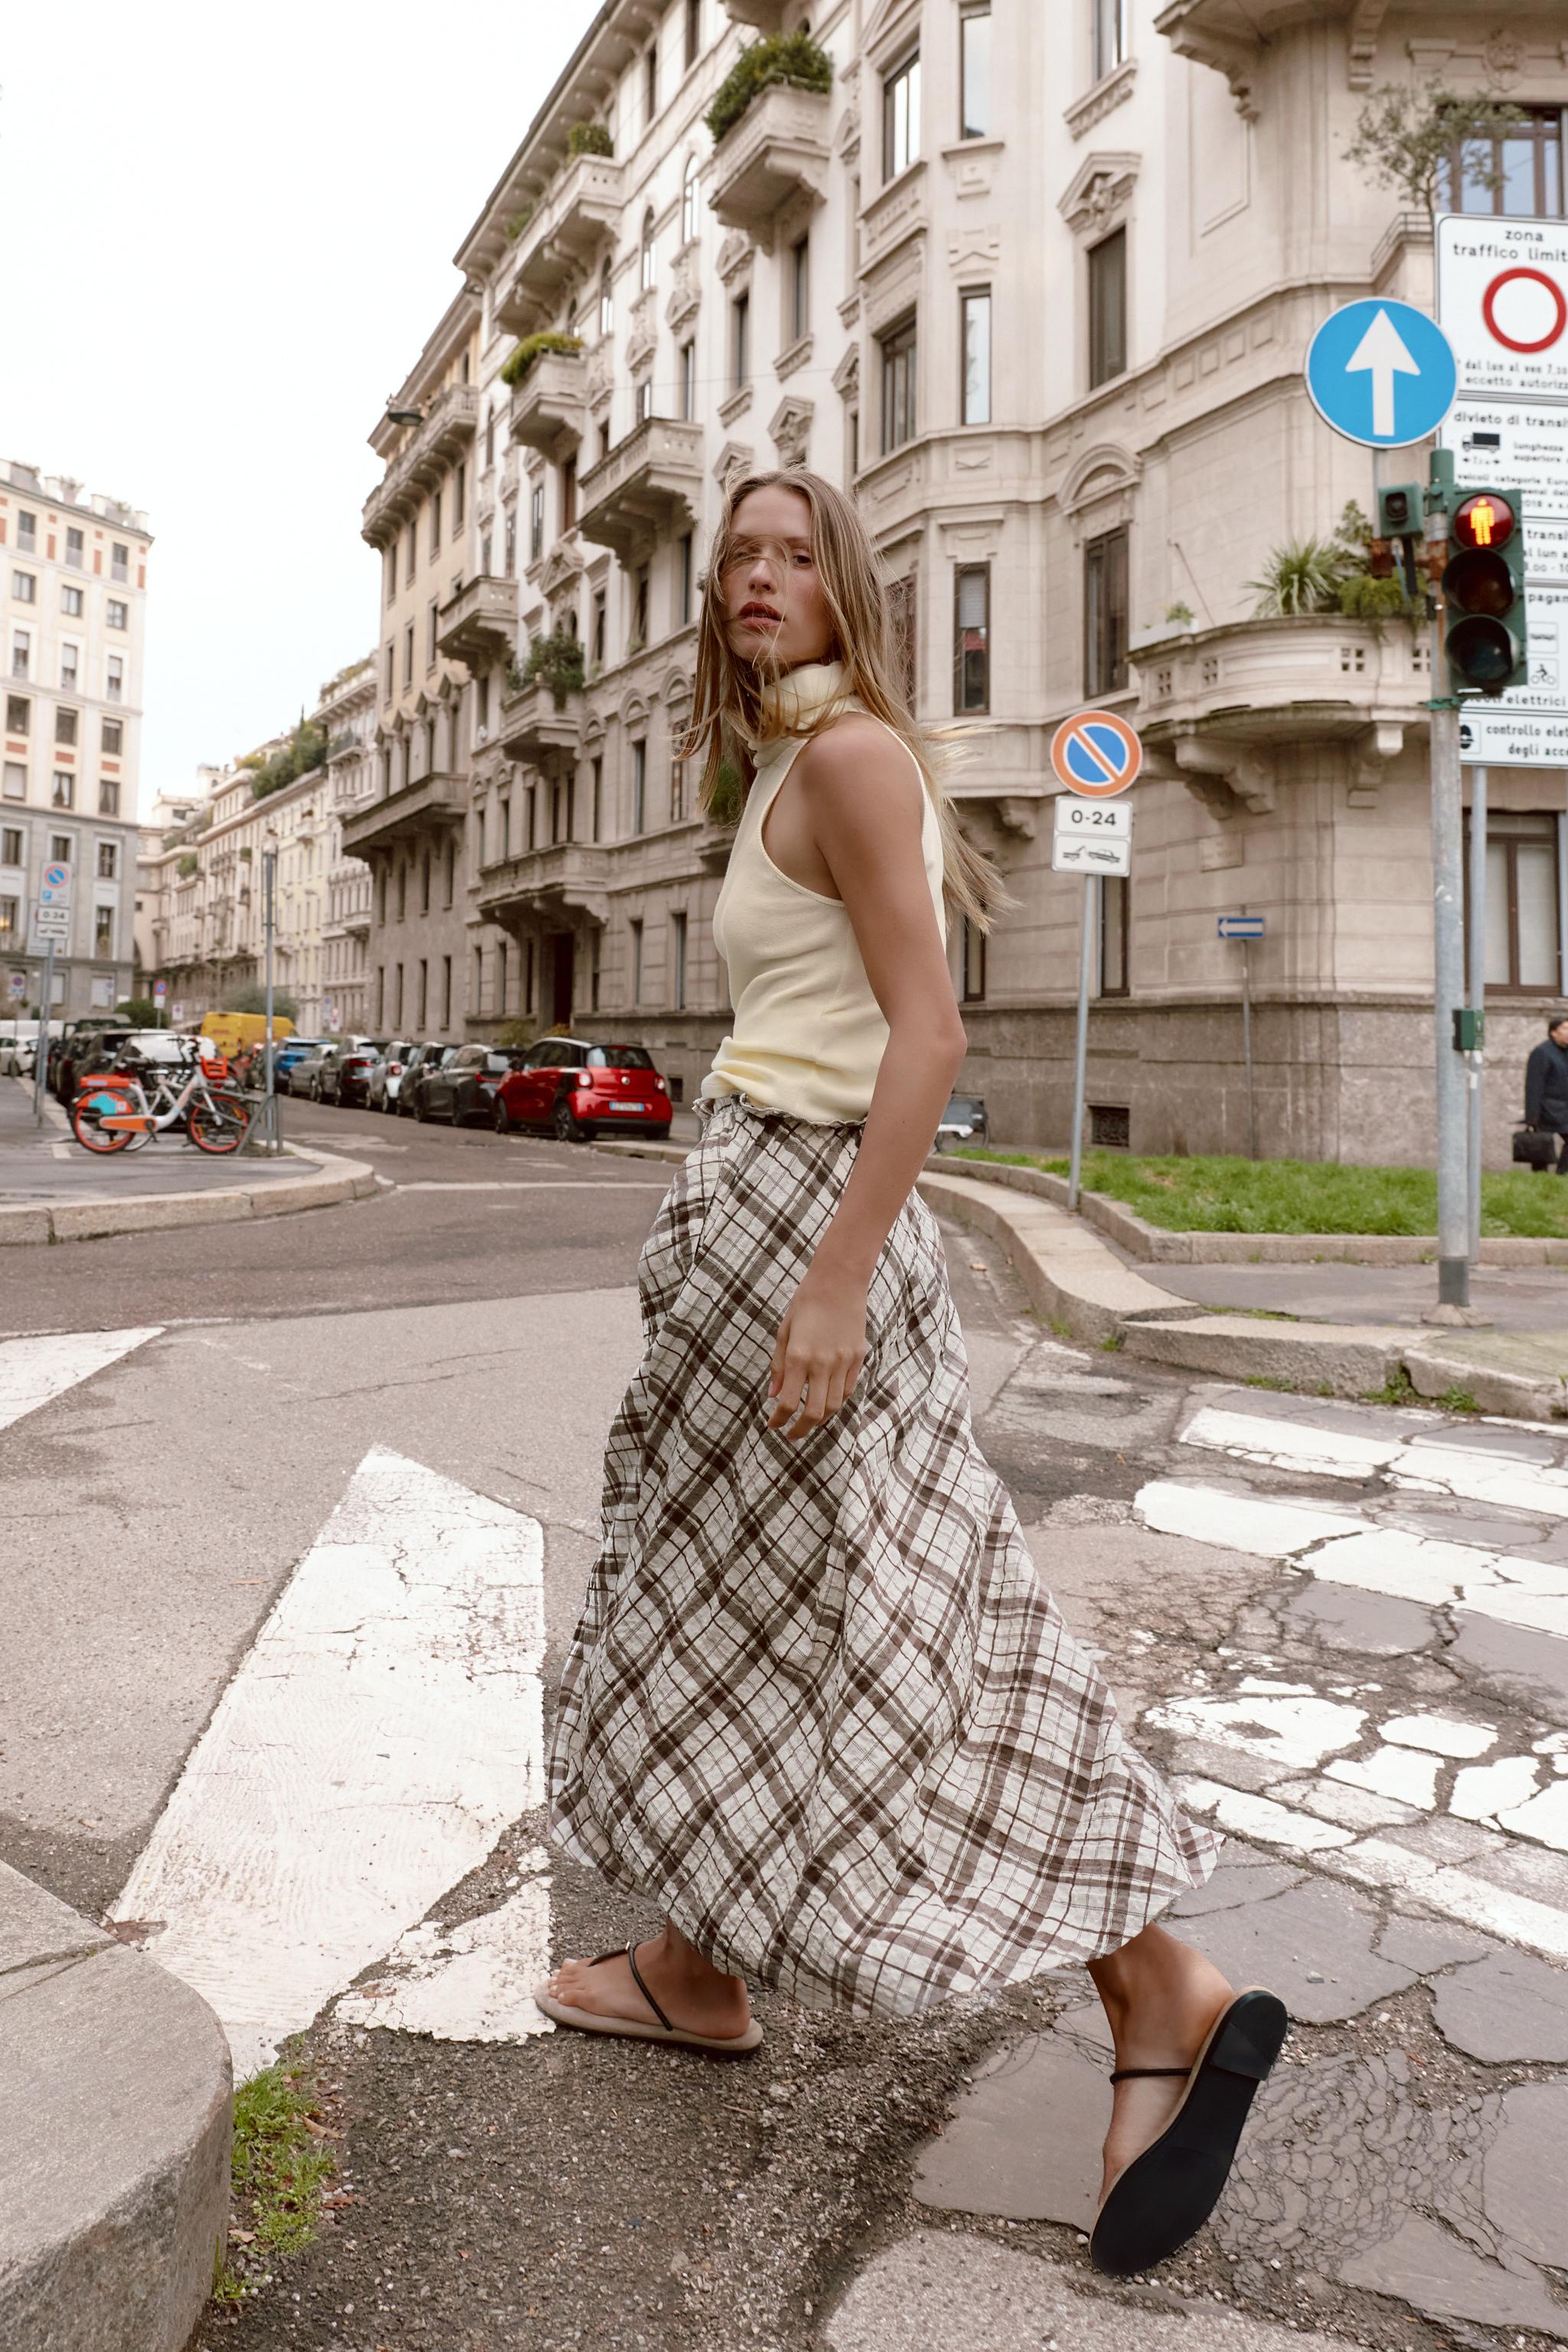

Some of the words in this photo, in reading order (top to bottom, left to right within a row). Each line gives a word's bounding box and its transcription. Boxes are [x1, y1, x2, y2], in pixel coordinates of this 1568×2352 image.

[1505, 230, 1544, 242] zona
[1453, 243, 1519, 260] traffico
[1465, 359, 1481, 370] dal
[1510, 361, 1519, 373] al
[1465, 377, 1512, 387] eccetto
[1455, 412, 1501, 424] divieto
[1507, 414, 1519, 426] di
[1507, 694, 1566, 707] elettrici
[1487, 723, 1541, 737] controllo
[1508, 742, 1539, 758] degli
[1071, 809, 1116, 826] 0-24
